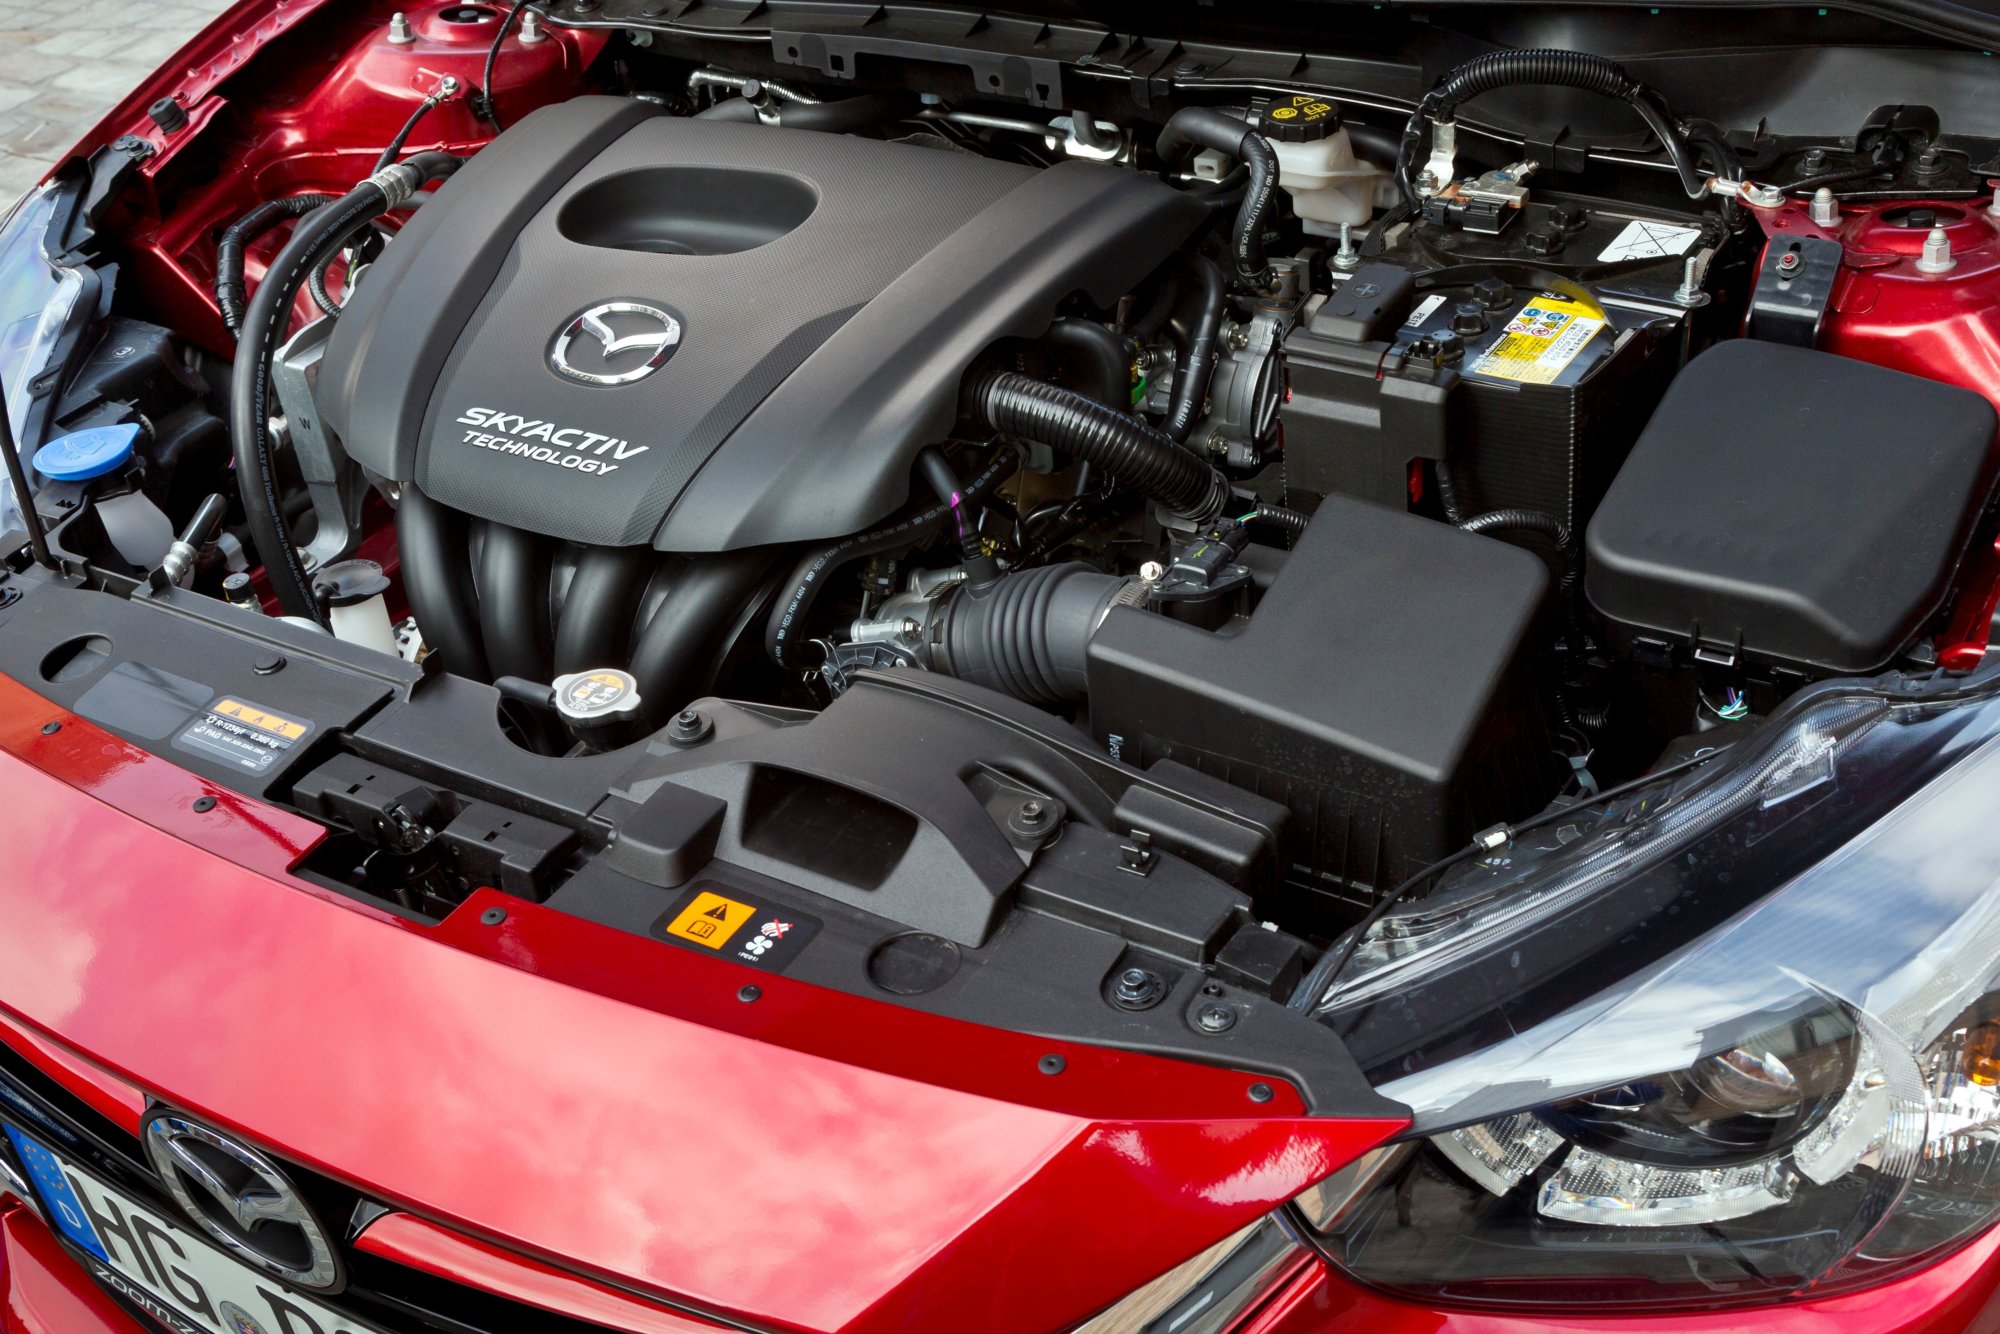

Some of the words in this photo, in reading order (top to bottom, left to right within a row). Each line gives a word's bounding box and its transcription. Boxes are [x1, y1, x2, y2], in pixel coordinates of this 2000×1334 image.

[1265, 159, 1275, 173] DOT
[1255, 186, 1270, 208] 050414
[256, 363, 265, 425] GOODYEAR
[256, 427, 269, 468] GALAXY
[456, 407, 650, 461] SKYACTIV
[462, 430, 620, 477] TECHNOLOGY
[299, 581, 314, 610] SUCTION
[204, 728, 222, 740] PAG
[214, 719, 247, 735] R-1234yf
[268, 738, 280, 749] kg
[56, 1199, 83, 1230] D
[64, 1170, 222, 1328] HG
